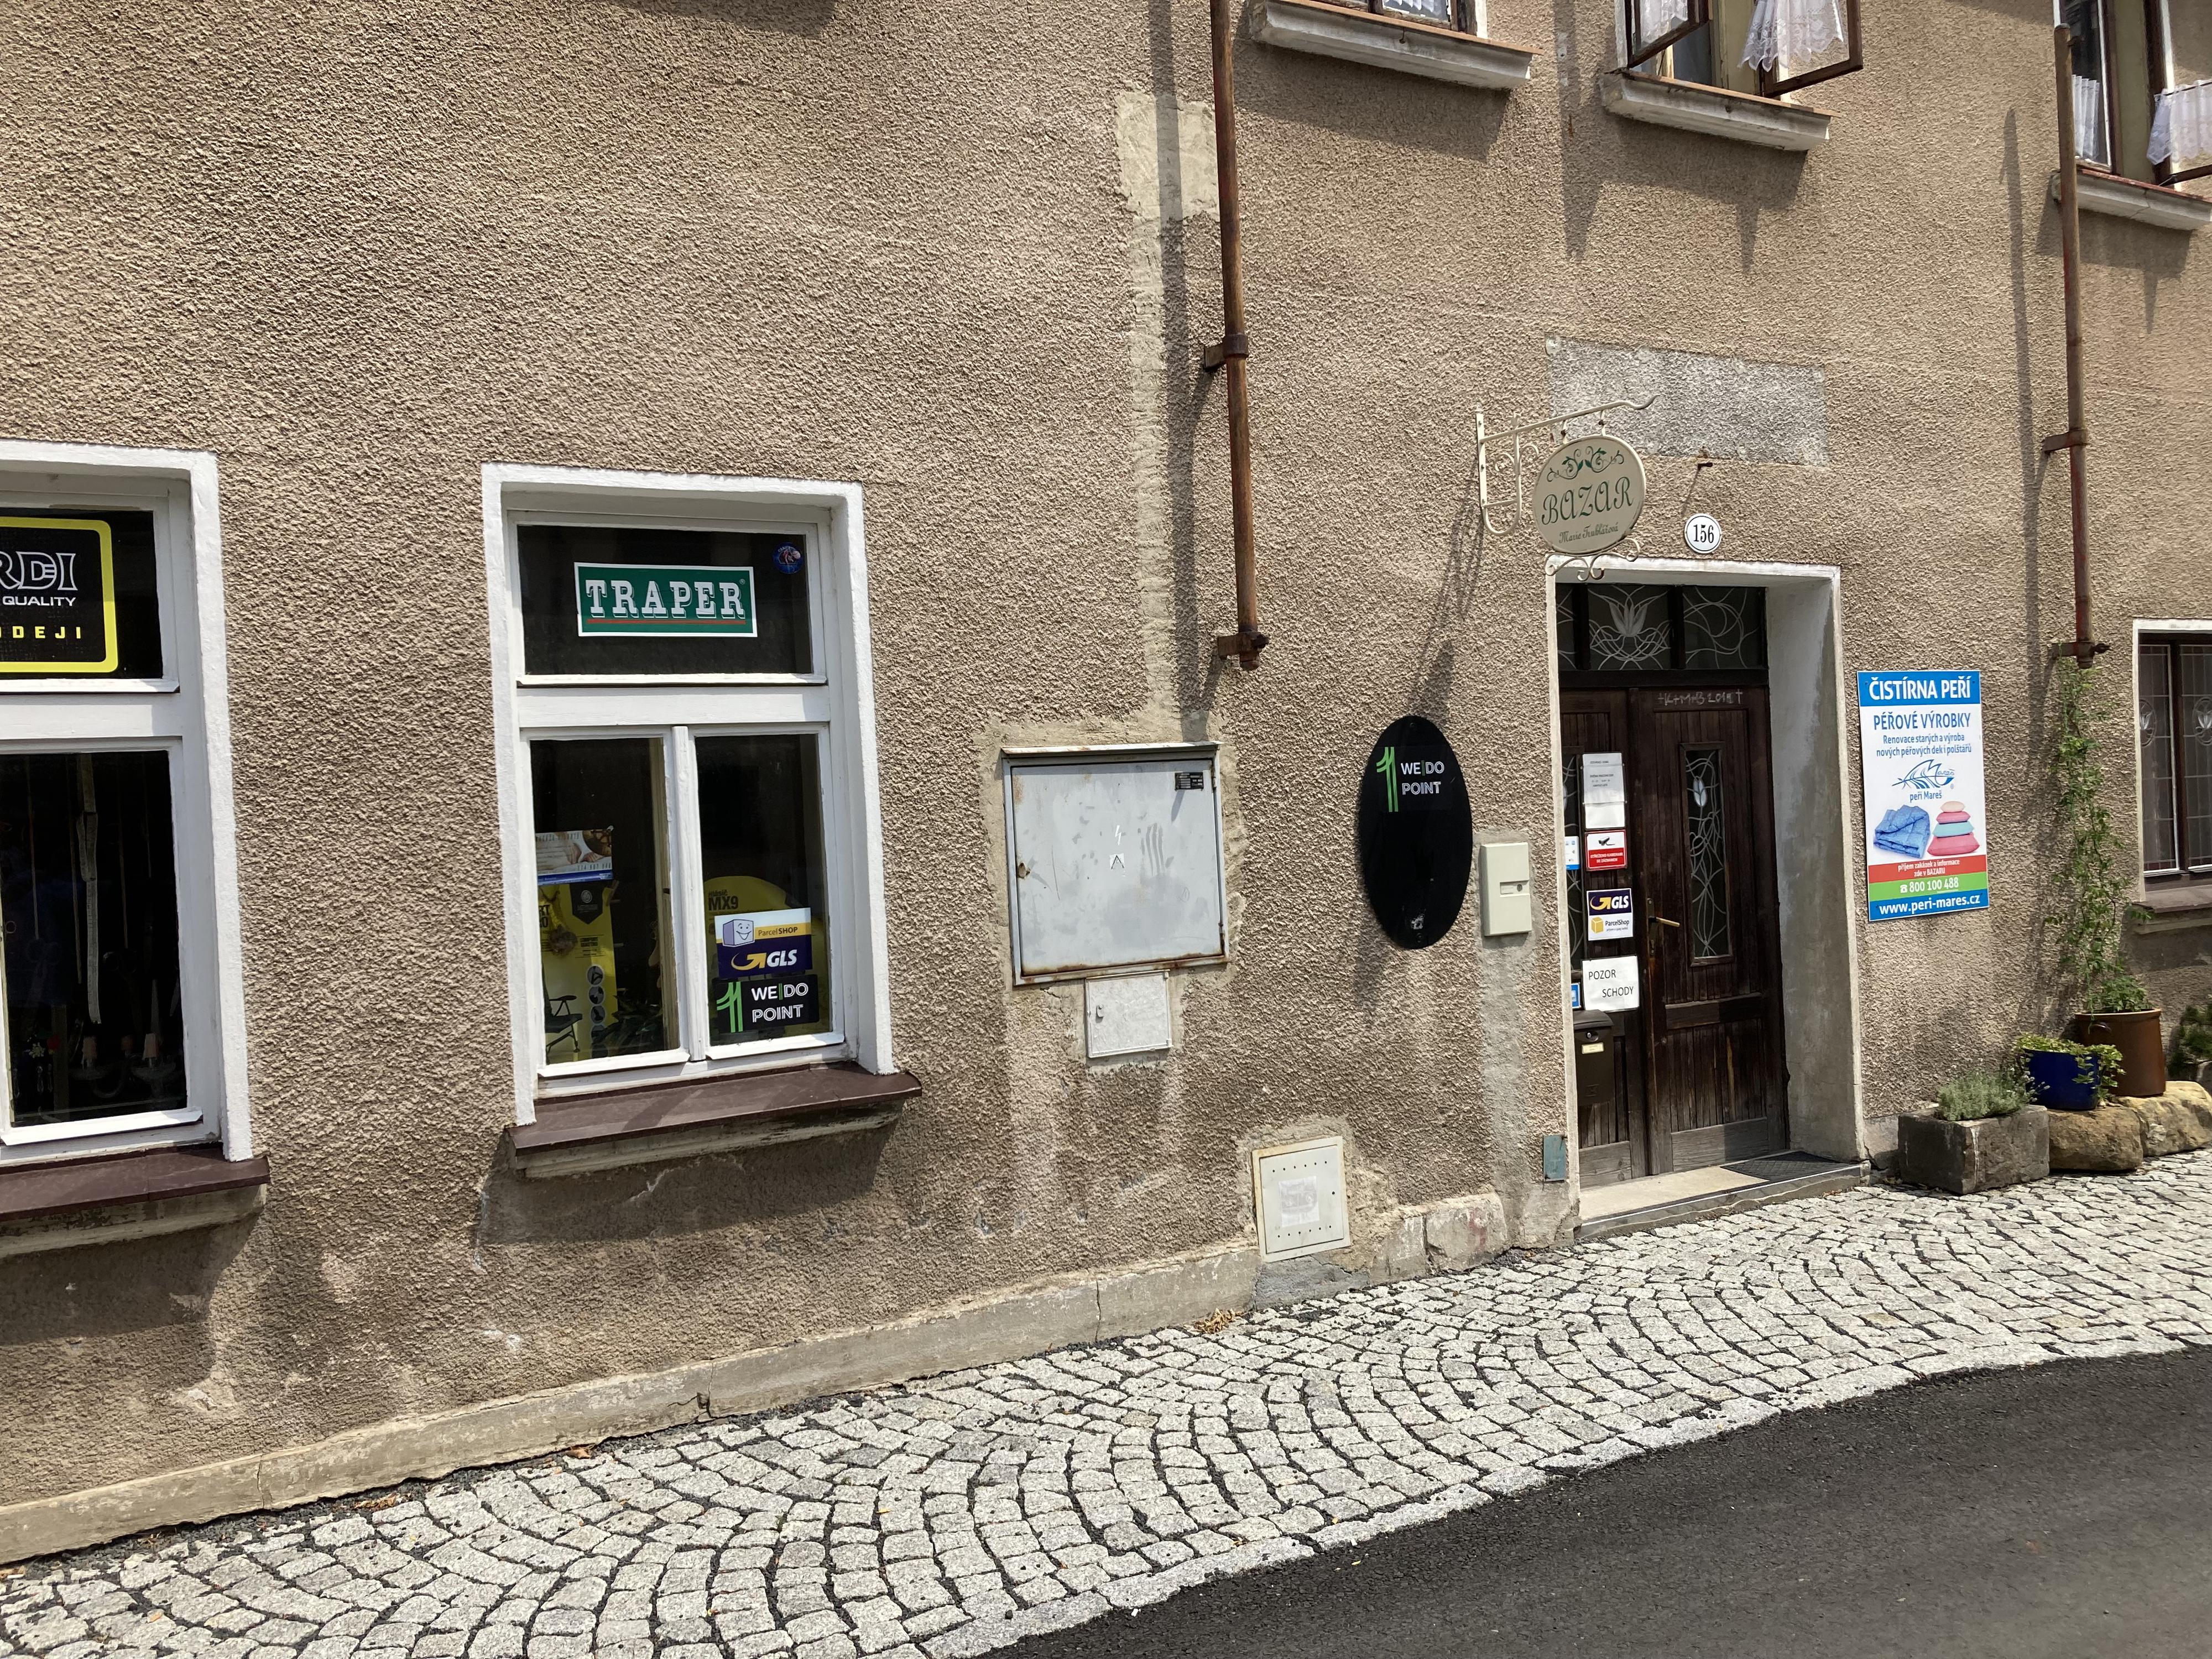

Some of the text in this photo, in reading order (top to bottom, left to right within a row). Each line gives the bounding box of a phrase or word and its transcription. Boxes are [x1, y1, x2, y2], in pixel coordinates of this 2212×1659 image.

[1542, 476, 1632, 525] BAZAR
[1559, 530, 1581, 543] Marie
[1693, 525, 1714, 543] 156
[2, 596, 76, 606] QUALITY
[585, 580, 745, 619] TRAPER
[0, 625, 81, 639] DEJI
[1869, 676, 1972, 700] ČISTÍRNA PEŘÍ
[1874, 710, 1971, 730] PÉŘOVÉ VÝROBKY
[1883, 735, 1914, 744] Renovace
[1916, 733, 1939, 744] starých
[1944, 733, 1965, 744] výroba
[1876, 747, 1900, 759] nových
[1901, 745, 1931, 758] péřových
[1932, 745, 1942, 754] dek
[1402, 781, 1441, 795] POINT
[1924, 790, 1942, 800] Mareš
[1897, 863, 1914, 872] příjem
[1909, 877, 1959, 893] 800 100 488
[708, 895, 739, 911] MX9
[1611, 896, 1629, 909] GLS
[1879, 895, 1980, 915] www.peri-mares.cz
[758, 927, 798, 936] ParcelSHOP
[767, 950, 797, 967] GLS
[1589, 969, 1616, 980] POZOR
[1602, 986, 1634, 998] SCHODY
[752, 1004, 804, 1023] POINT
